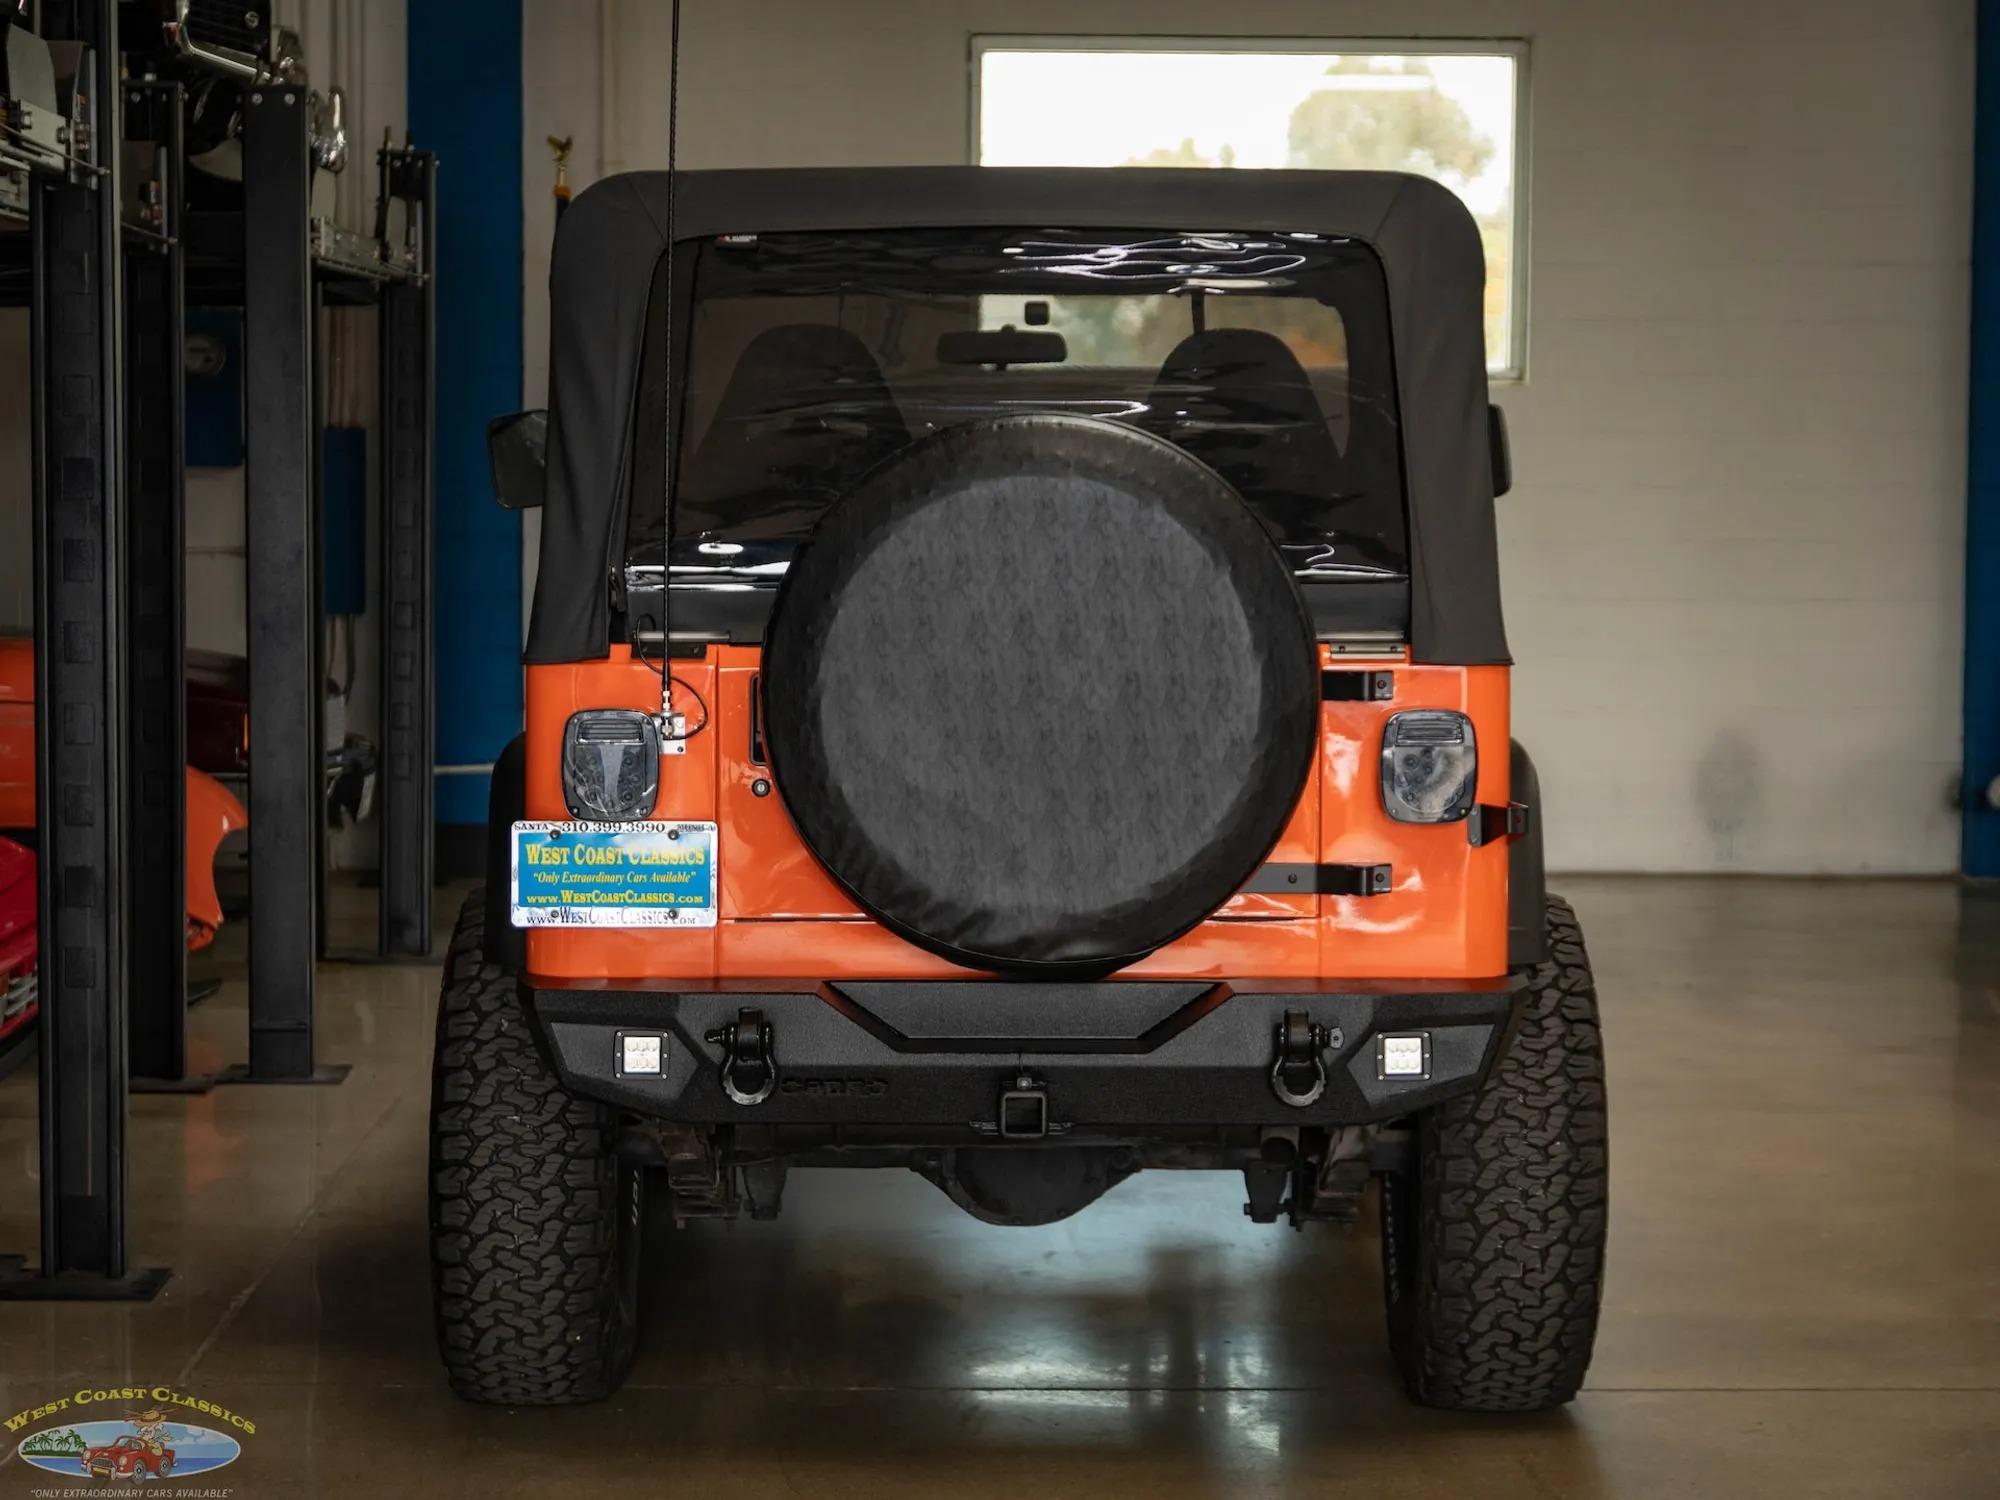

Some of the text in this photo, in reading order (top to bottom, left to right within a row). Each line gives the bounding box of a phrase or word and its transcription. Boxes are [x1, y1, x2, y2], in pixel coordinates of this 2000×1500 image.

[514, 822, 665, 832] SANTA 310.399.3990
[525, 843, 705, 865] WEST COAST CLASSICS
[562, 871, 624, 886] Extraordinary
[627, 871, 647, 884] Cars
